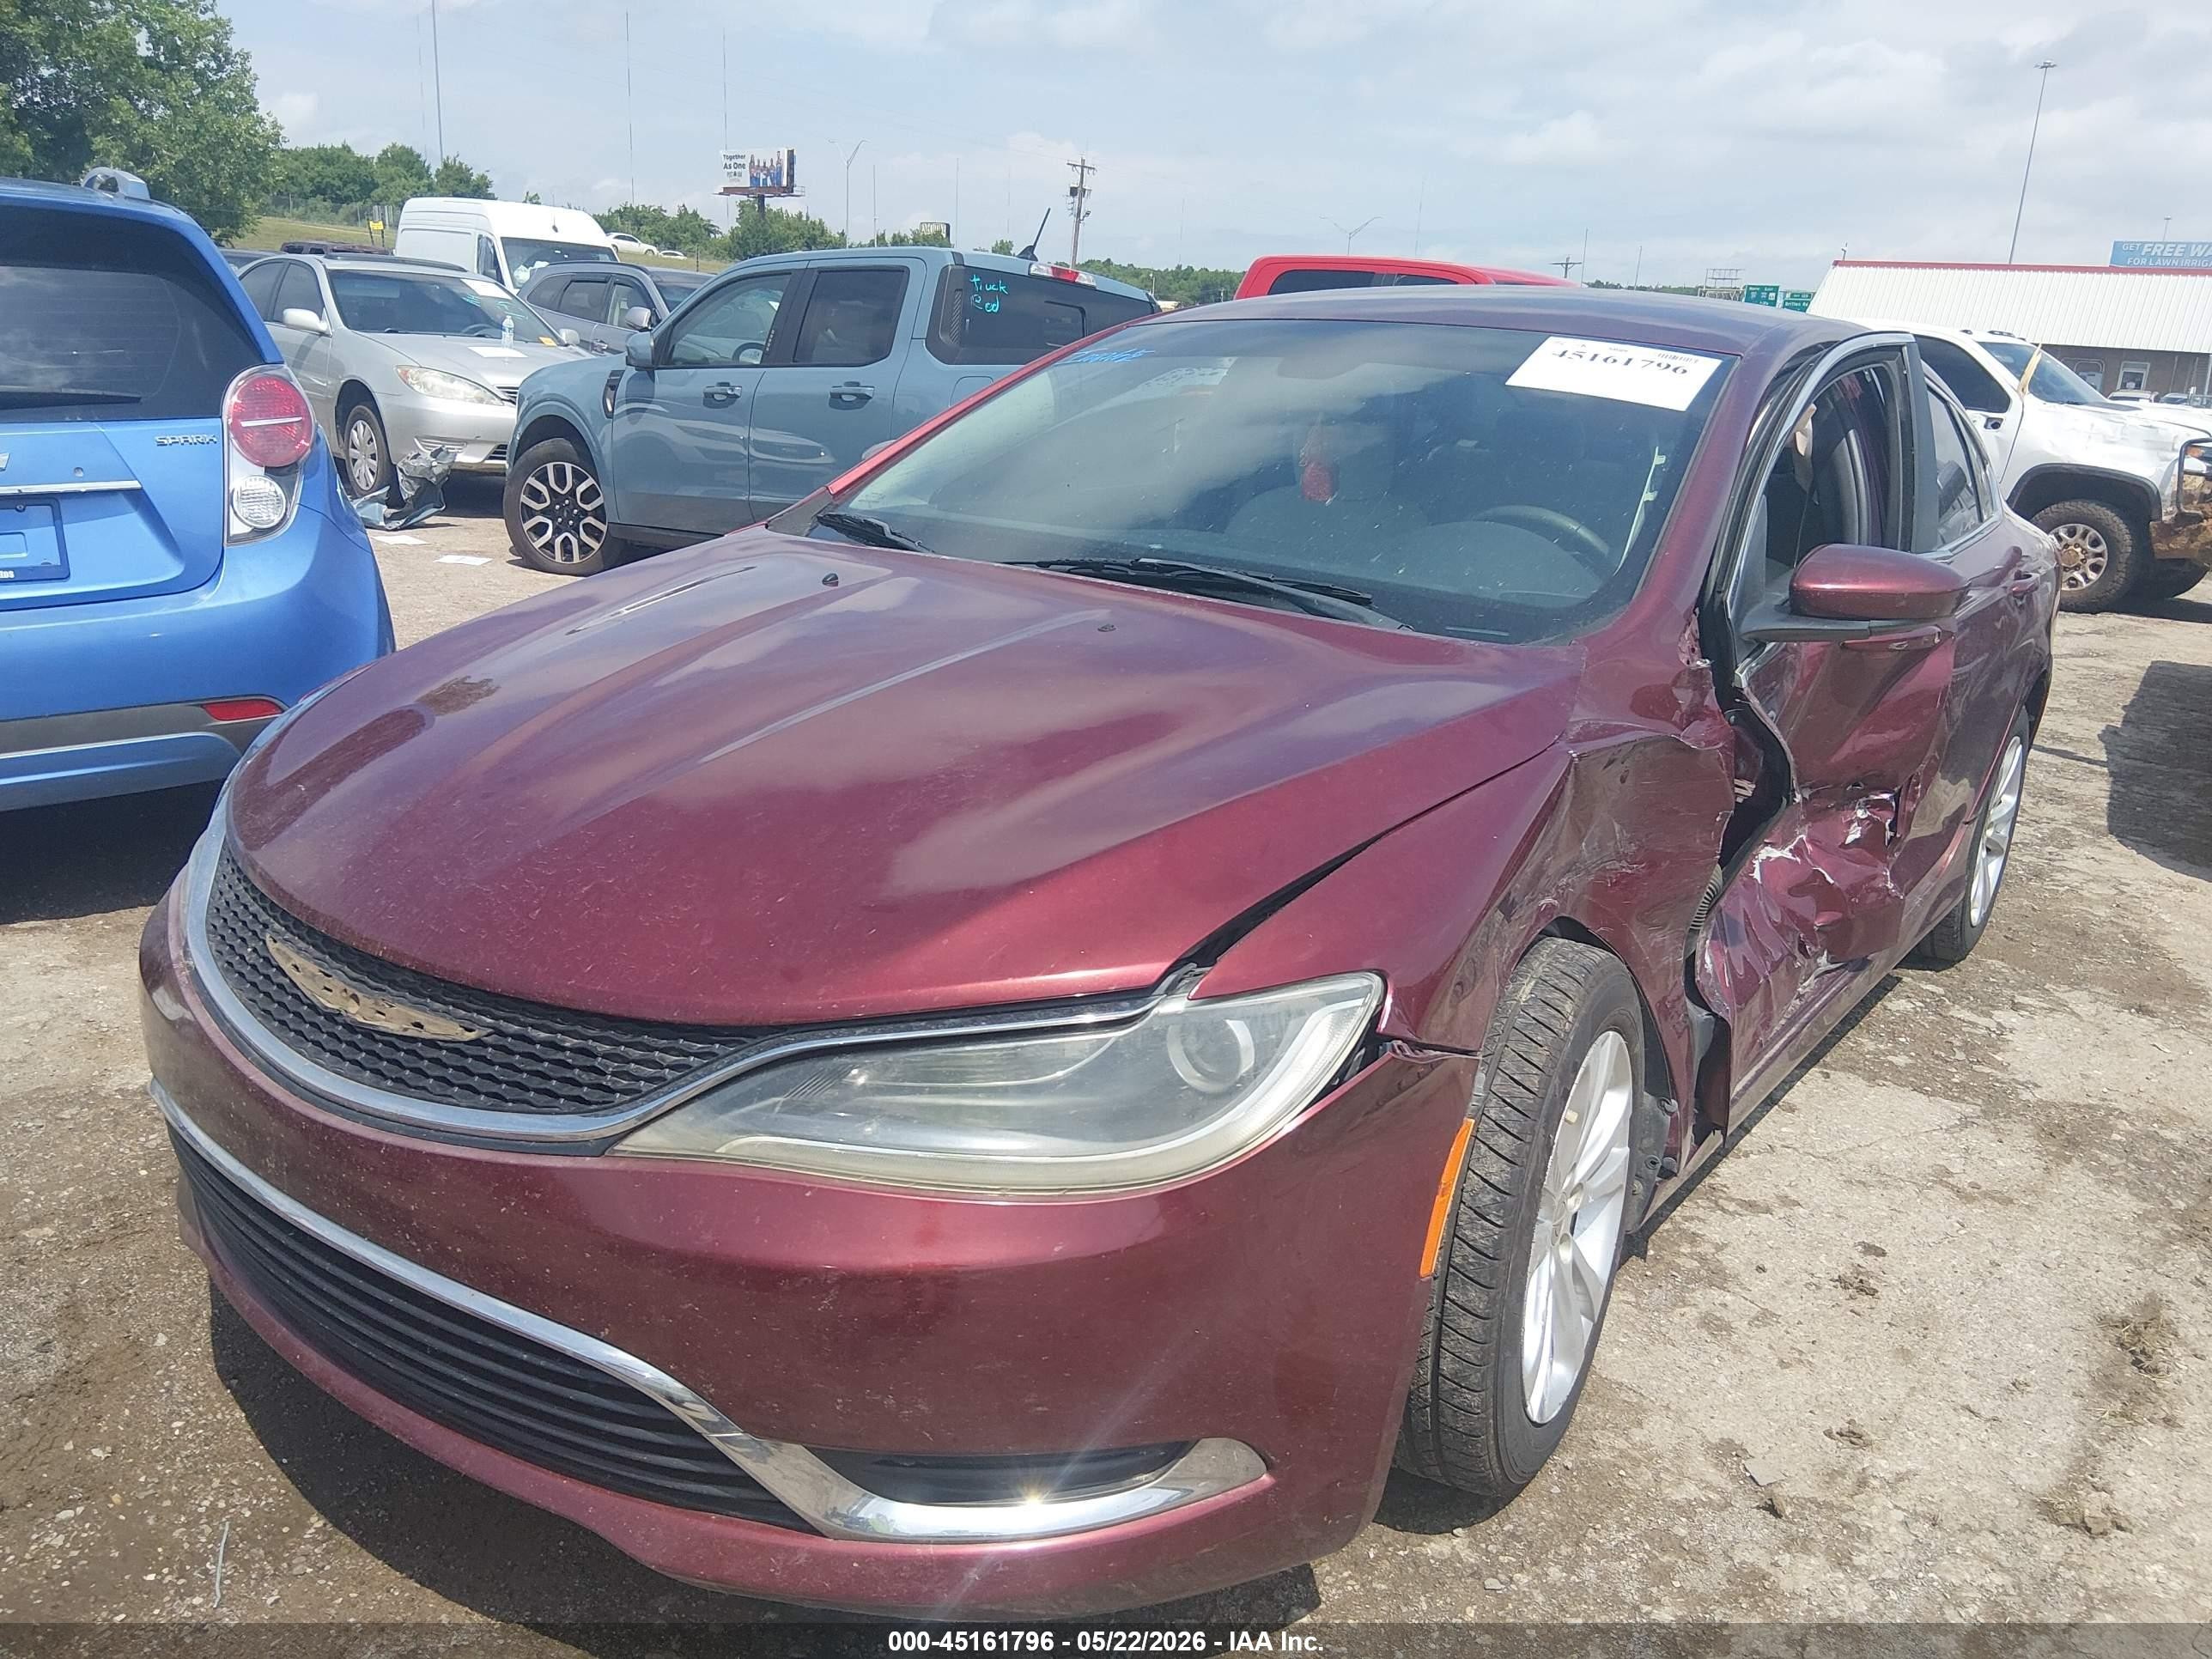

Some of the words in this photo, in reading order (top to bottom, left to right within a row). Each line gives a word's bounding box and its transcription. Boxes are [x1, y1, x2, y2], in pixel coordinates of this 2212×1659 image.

[2122, 242, 2142, 252] GET
[2142, 243, 2186, 257] FREE
[2127, 258, 2148, 266] FOR
[2148, 258, 2179, 267] LAWN
[1551, 349, 1688, 375] 45161796
[155, 434, 218, 447] SPARK
